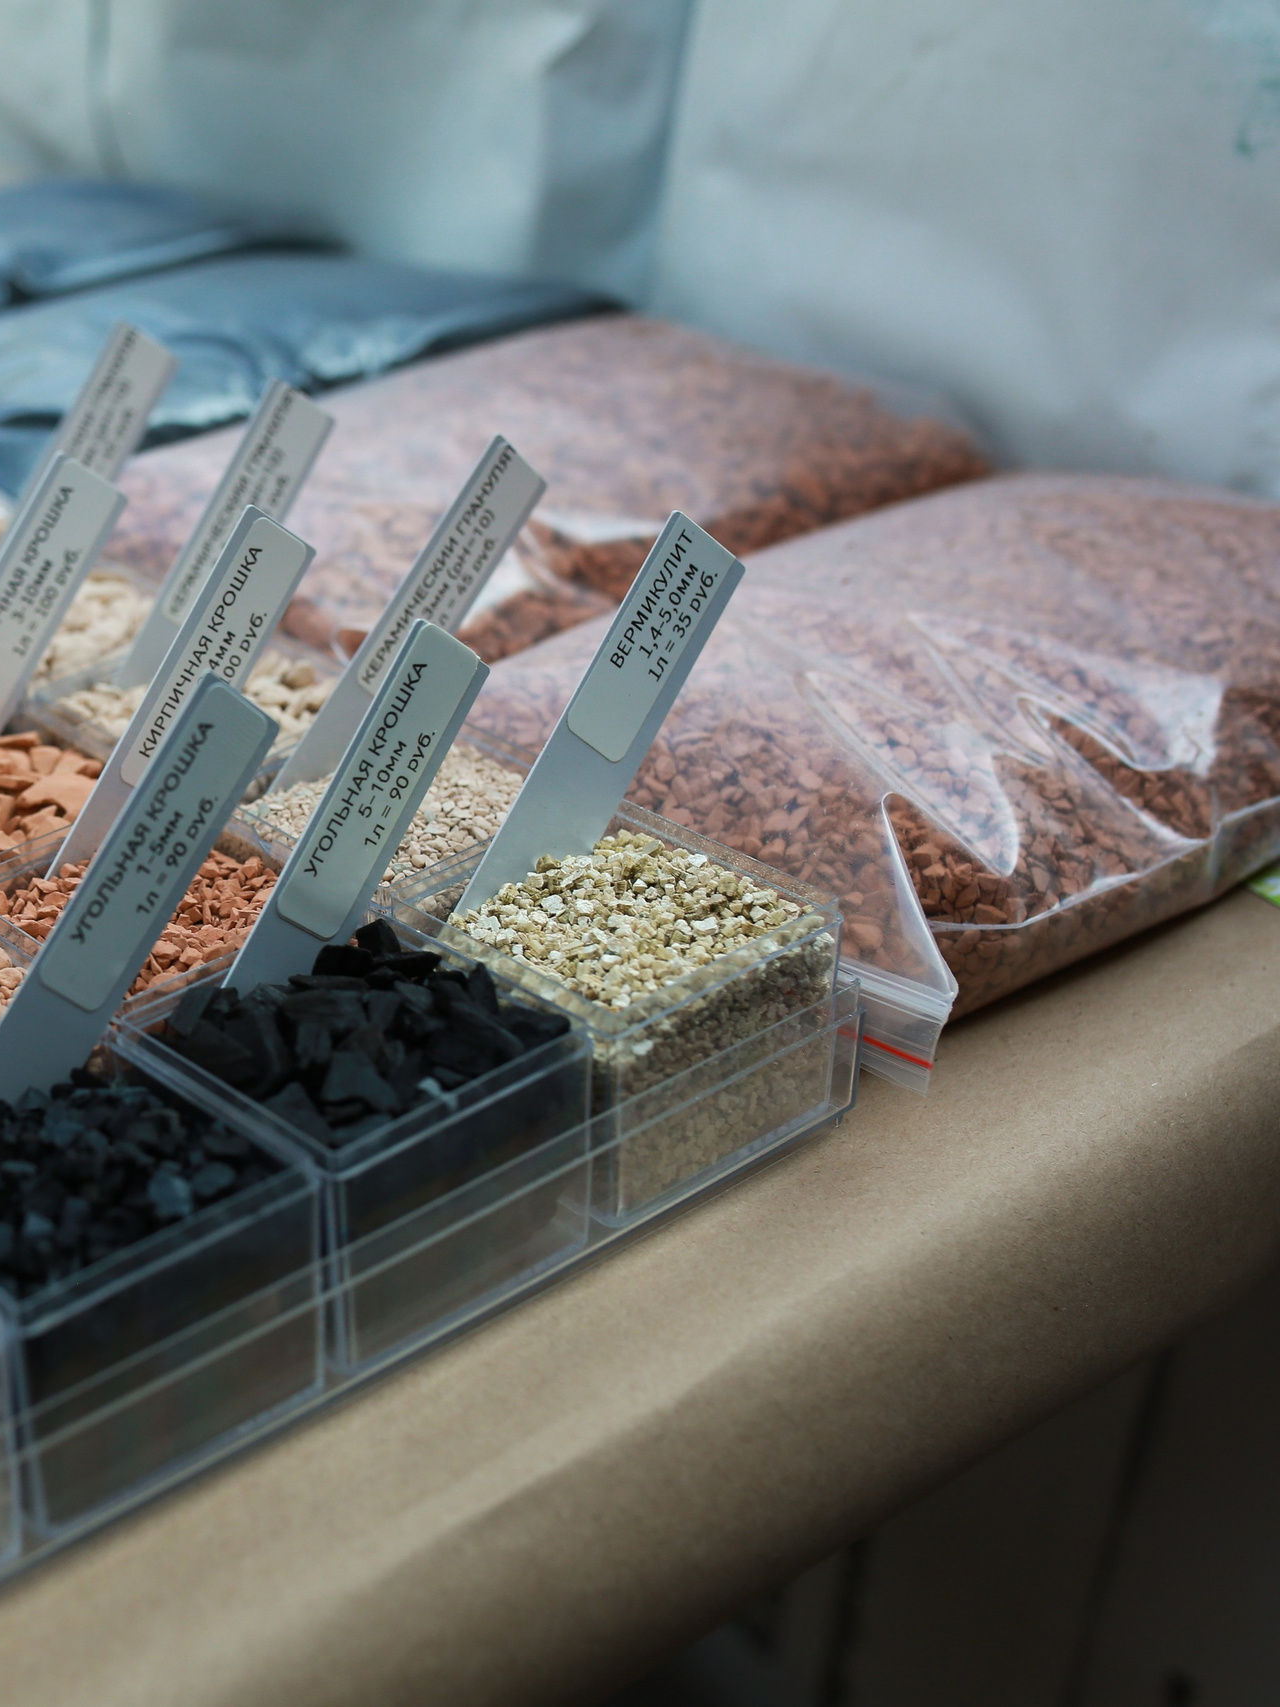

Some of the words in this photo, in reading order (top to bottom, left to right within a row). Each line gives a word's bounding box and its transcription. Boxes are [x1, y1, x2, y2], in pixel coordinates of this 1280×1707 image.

[24, 484, 74, 568] КРОШКА
[239, 612, 267, 653] руб.
[609, 528, 693, 669] ВЕРМИКУЛИТ
[639, 563, 699, 659] 1,4-5,0мм
[648, 656, 669, 682] 1л
[673, 612, 691, 638] 35
[689, 571, 718, 613] руб.
[138, 635, 213, 758] КИРПИЧНАЯ
[207, 546, 263, 634] КРОШКА
[304, 759, 374, 877] УГОЛЬНАЯ
[368, 661, 428, 757] КРОШКА
[358, 740, 407, 819] 5-10мм
[364, 823, 385, 846] 1л
[389, 775, 409, 801] 90
[407, 730, 437, 773] руб.
[70, 822, 151, 944] УГОЛЬНАЯ
[145, 721, 214, 823] КРОШКА
[136, 811, 185, 876] 1-5мм
[136, 890, 159, 915] 1л
[165, 840, 188, 868] 90
